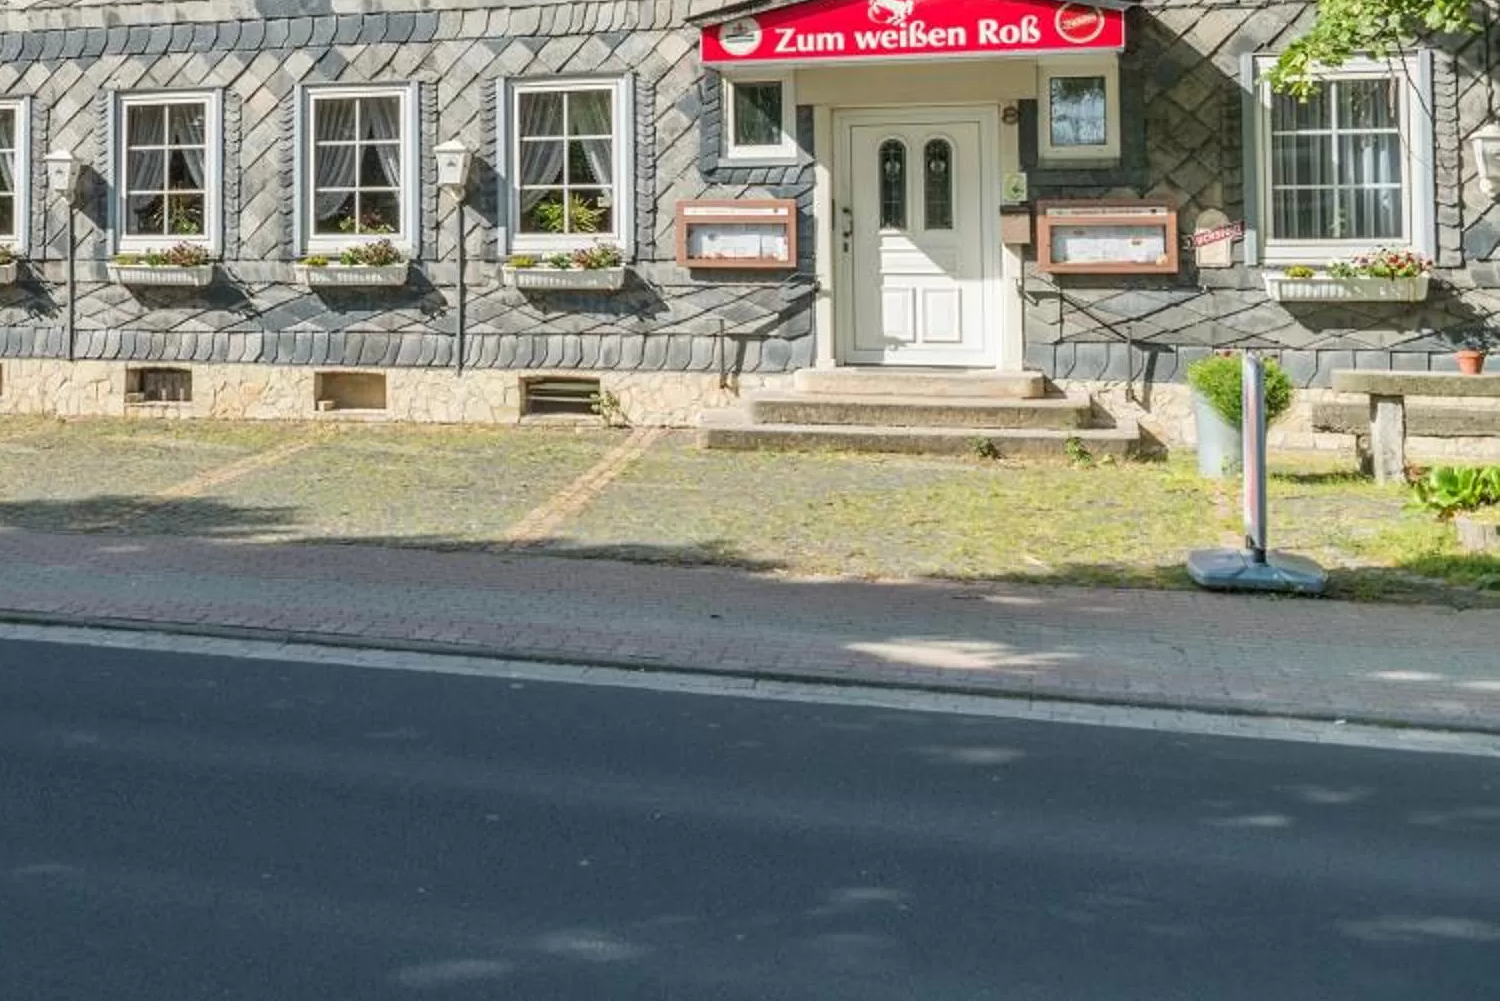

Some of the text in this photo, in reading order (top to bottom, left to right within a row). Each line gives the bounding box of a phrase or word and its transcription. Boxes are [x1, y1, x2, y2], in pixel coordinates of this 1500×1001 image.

[774, 28, 845, 52] Zum
[854, 20, 966, 49] weißen
[977, 14, 1041, 45] Roß
